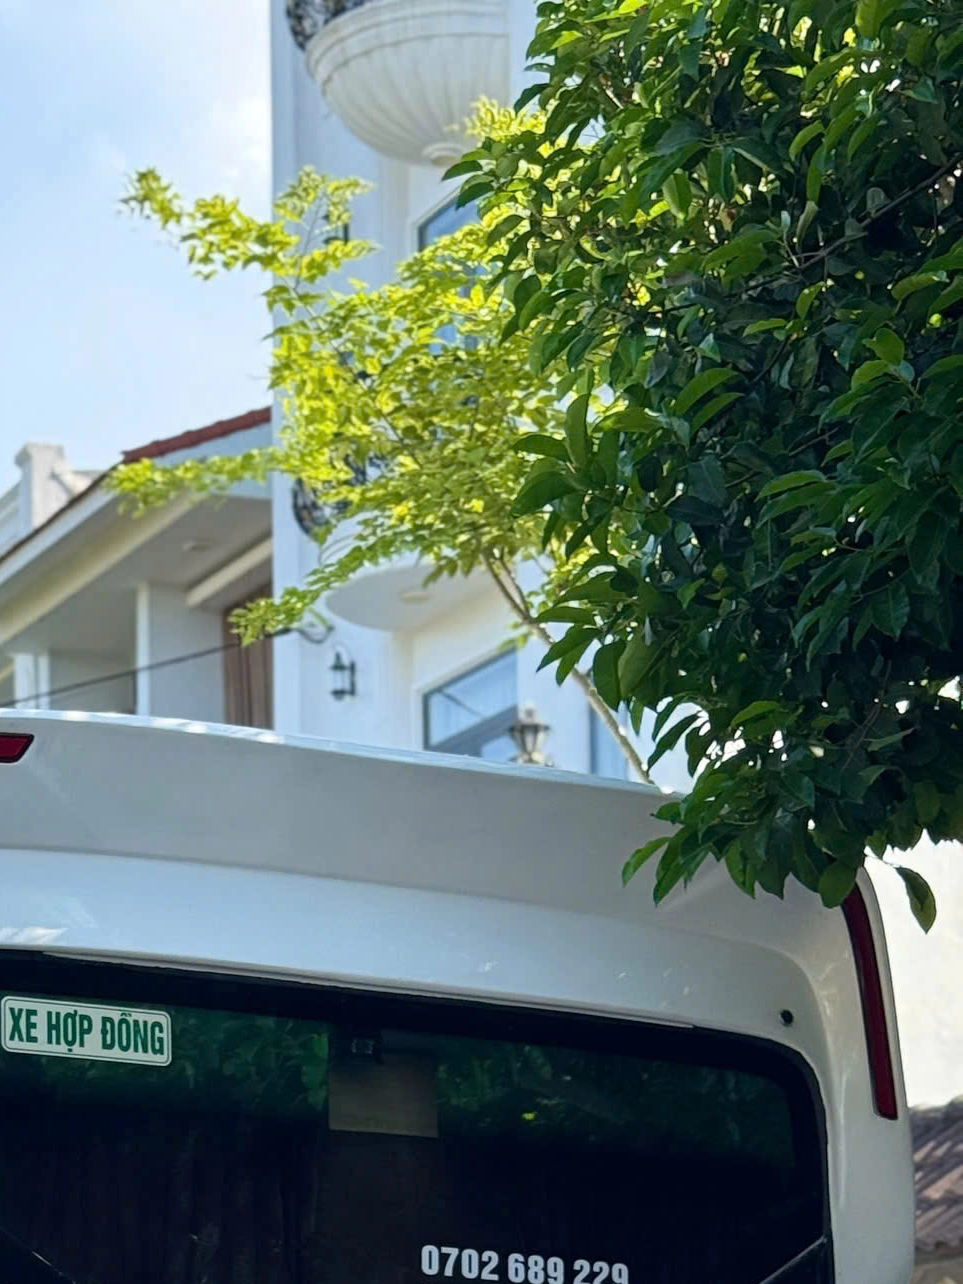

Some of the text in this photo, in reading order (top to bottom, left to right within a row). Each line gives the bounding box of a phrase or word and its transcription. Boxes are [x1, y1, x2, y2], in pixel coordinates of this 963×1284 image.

[8, 1006, 165, 1056] XE HỢP ĐỒNG
[421, 1244, 499, 1281] 0702
